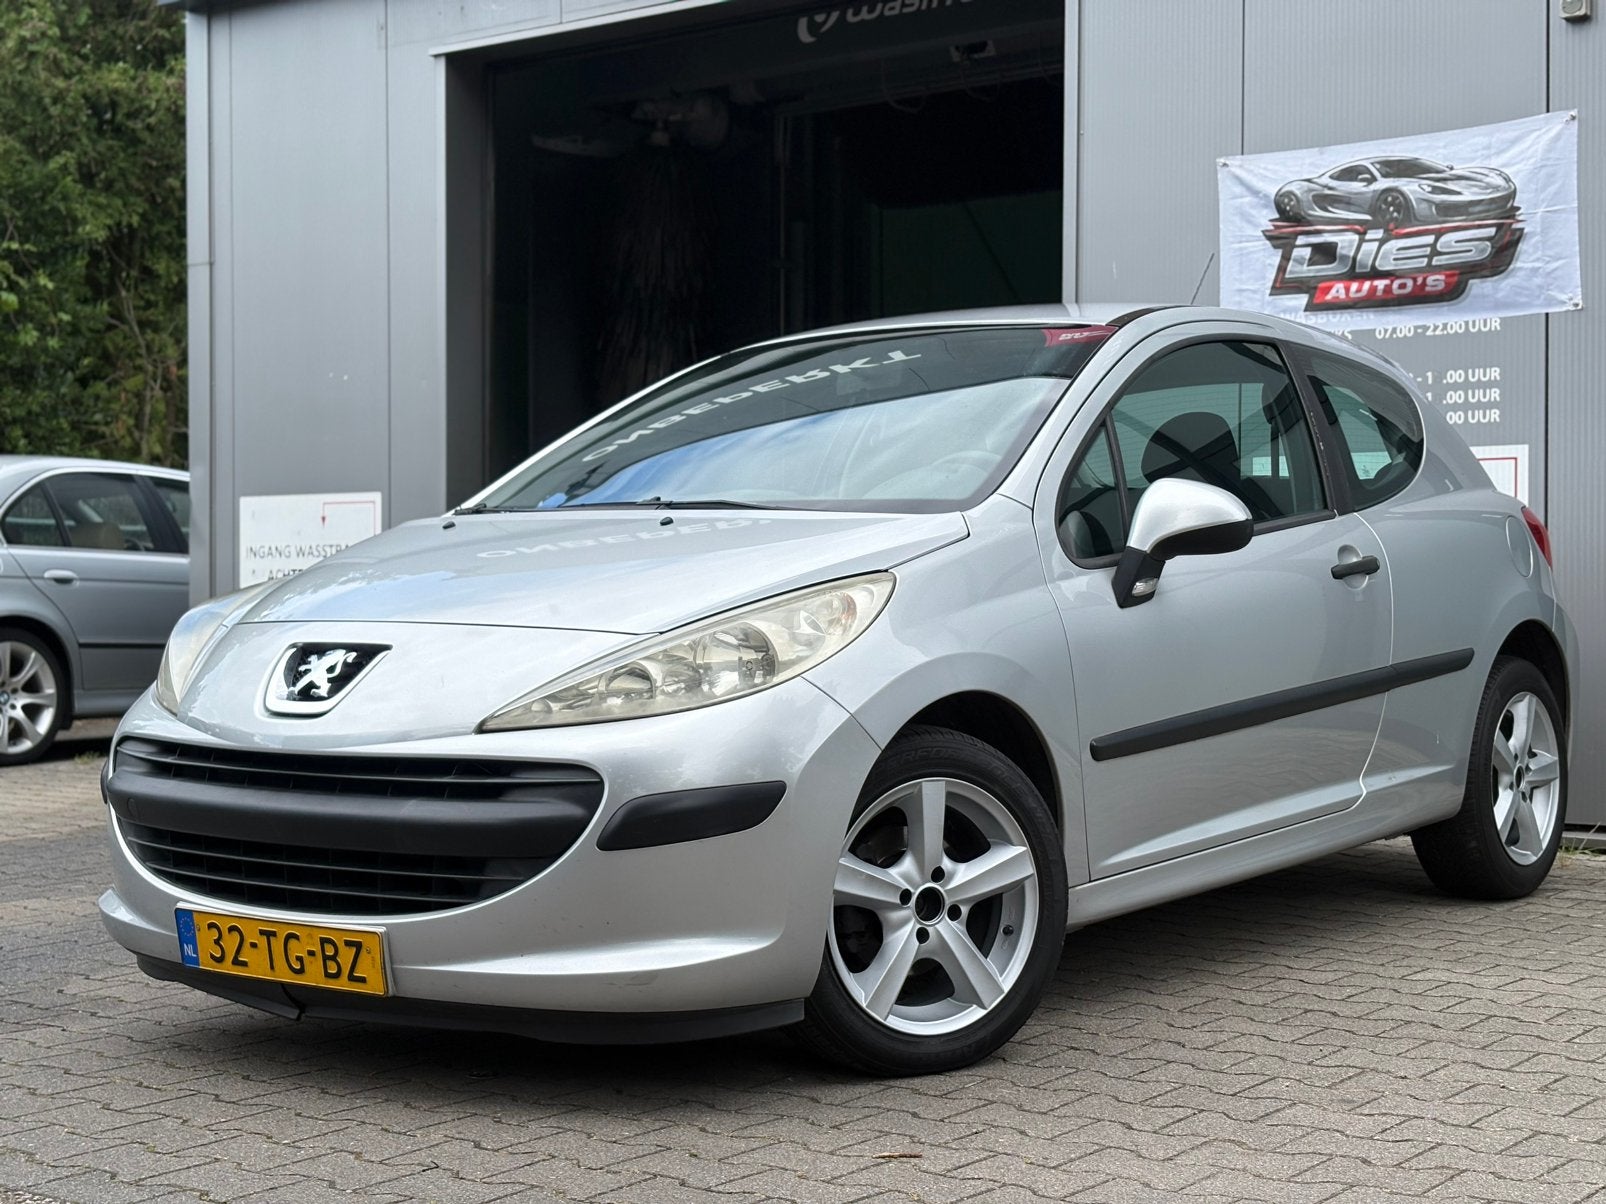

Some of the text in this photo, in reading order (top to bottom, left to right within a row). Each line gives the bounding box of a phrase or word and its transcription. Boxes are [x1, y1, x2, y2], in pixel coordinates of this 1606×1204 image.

[1325, 274, 1446, 299] AUTO'S
[1375, 325, 1414, 339] 07.00
[1425, 320, 1465, 335] 22.00
[1468, 317, 1501, 333] UUR
[1468, 366, 1501, 382] UUR
[1468, 387, 1501, 403] UUR
[1468, 408, 1501, 424] UUR
[246, 544, 291, 559] INGANG
[183, 943, 197, 958] NL
[206, 921, 367, 984] 32-TG-BZ
